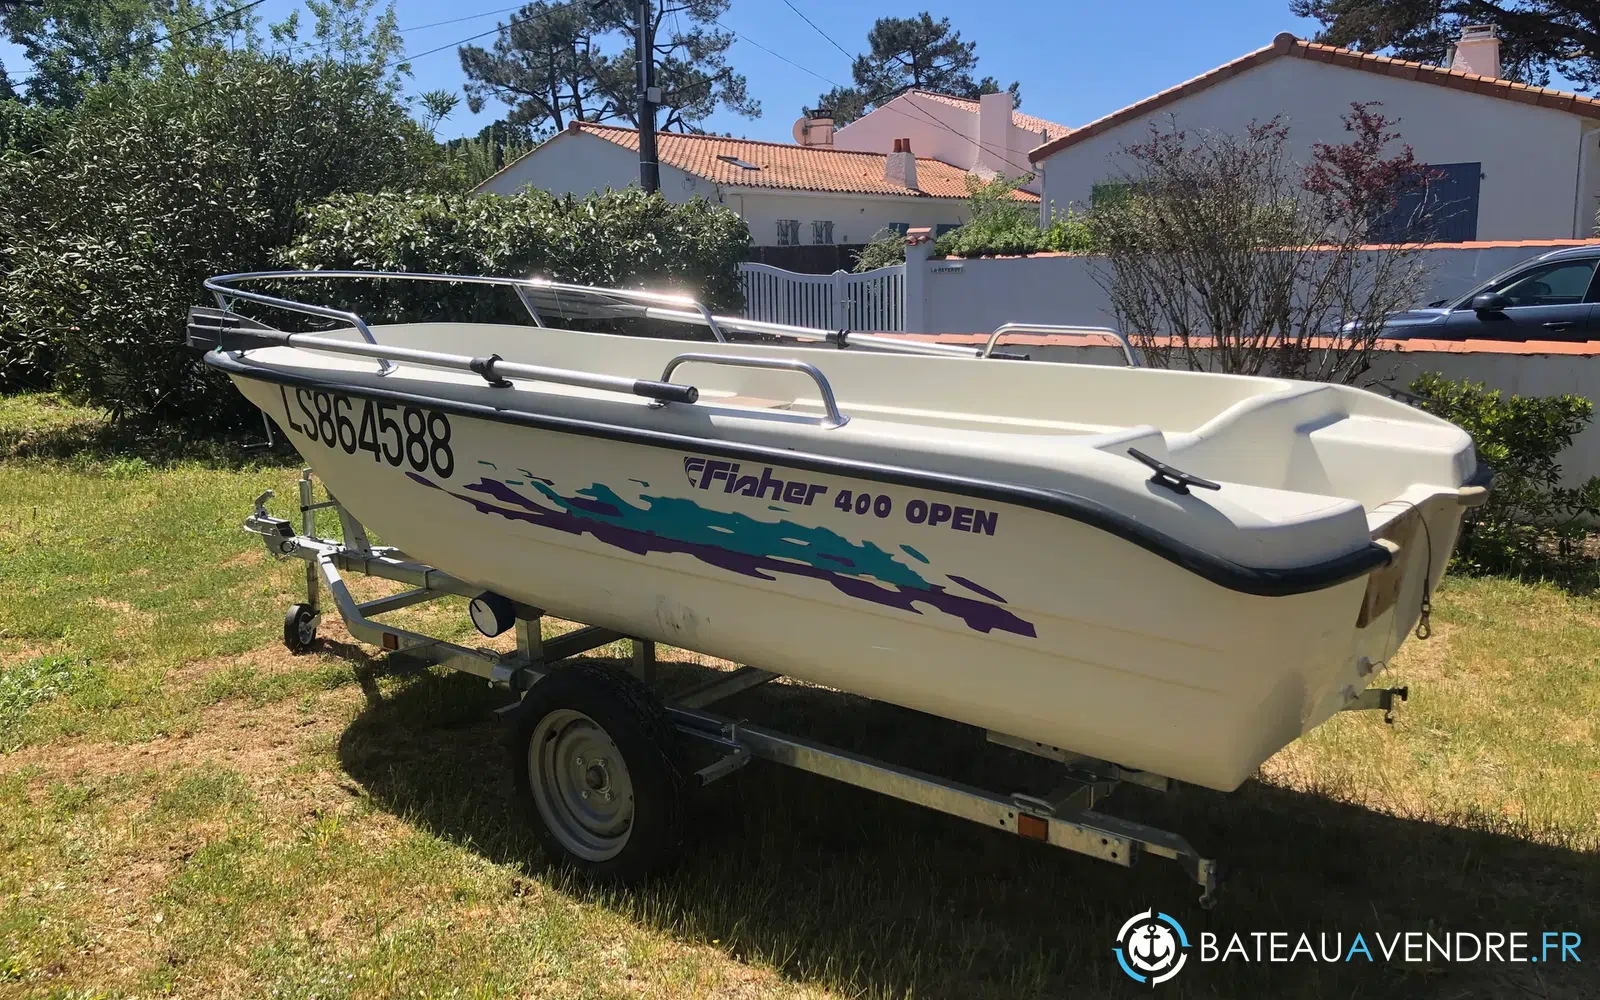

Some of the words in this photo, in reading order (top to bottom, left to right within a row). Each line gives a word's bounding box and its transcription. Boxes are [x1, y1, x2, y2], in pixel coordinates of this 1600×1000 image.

[280, 385, 454, 479] LS864588
[834, 489, 892, 518] 400
[905, 499, 998, 536] OPEN
